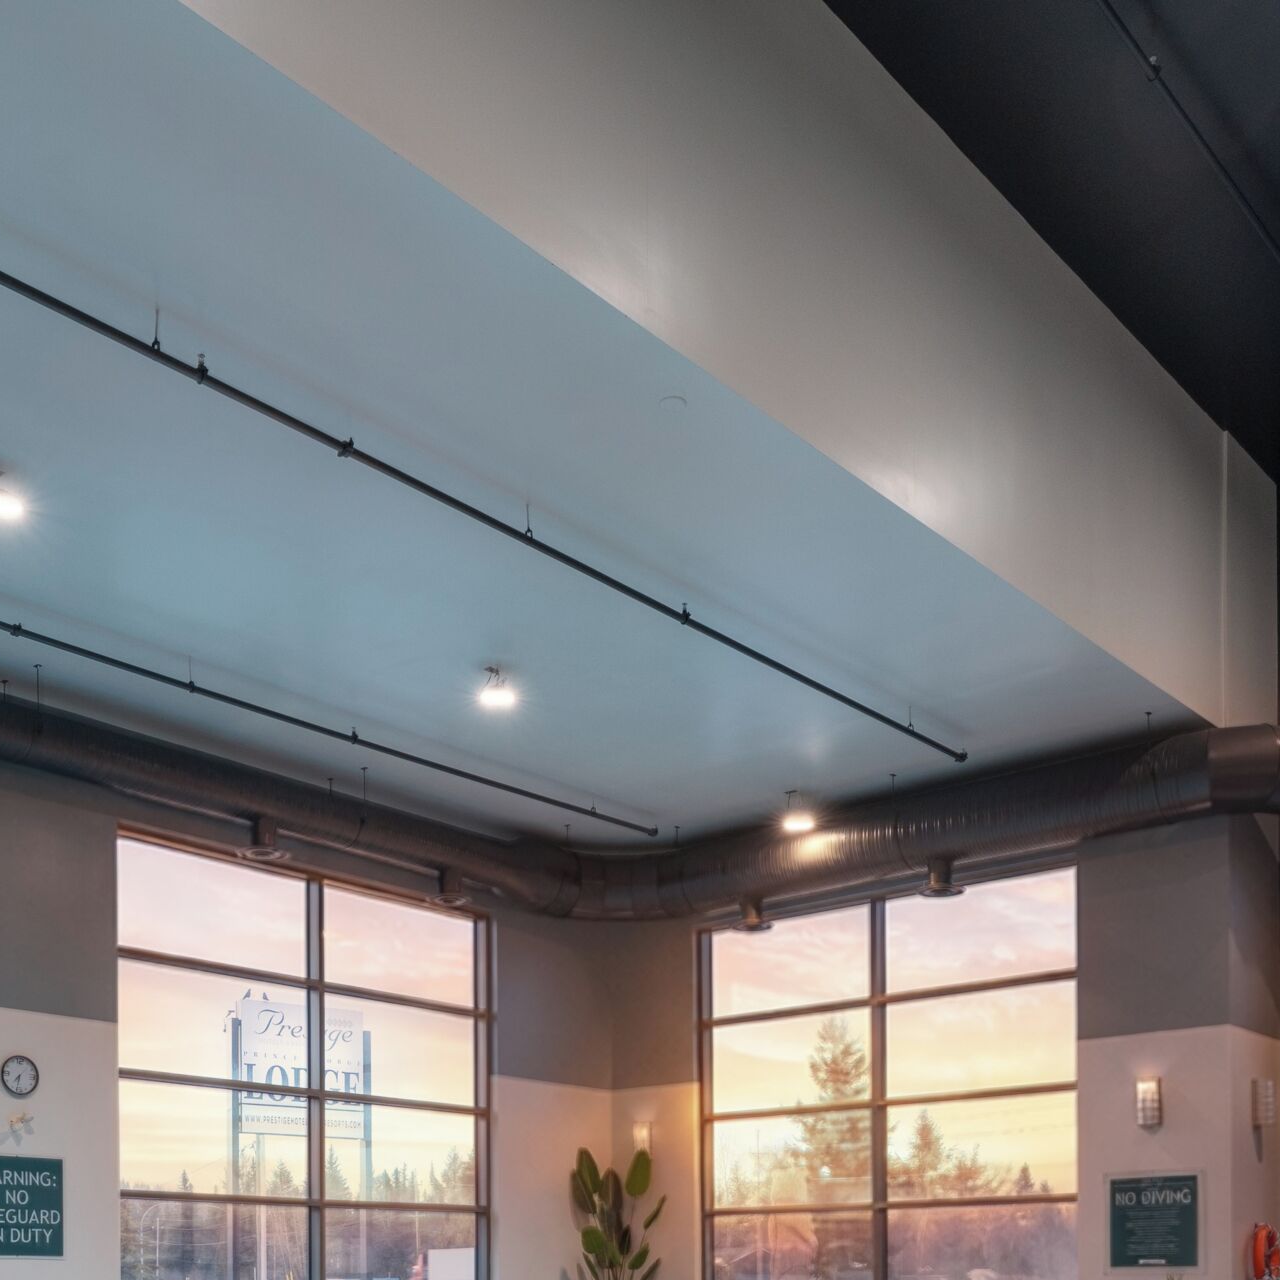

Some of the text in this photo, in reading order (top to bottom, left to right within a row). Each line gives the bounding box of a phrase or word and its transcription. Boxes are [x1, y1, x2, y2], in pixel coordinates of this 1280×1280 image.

[255, 1009, 353, 1051] Prege
[5, 1189, 29, 1205] NO
[1115, 1189, 1192, 1206] NO DIVING
[10, 1227, 53, 1243] DUTY
